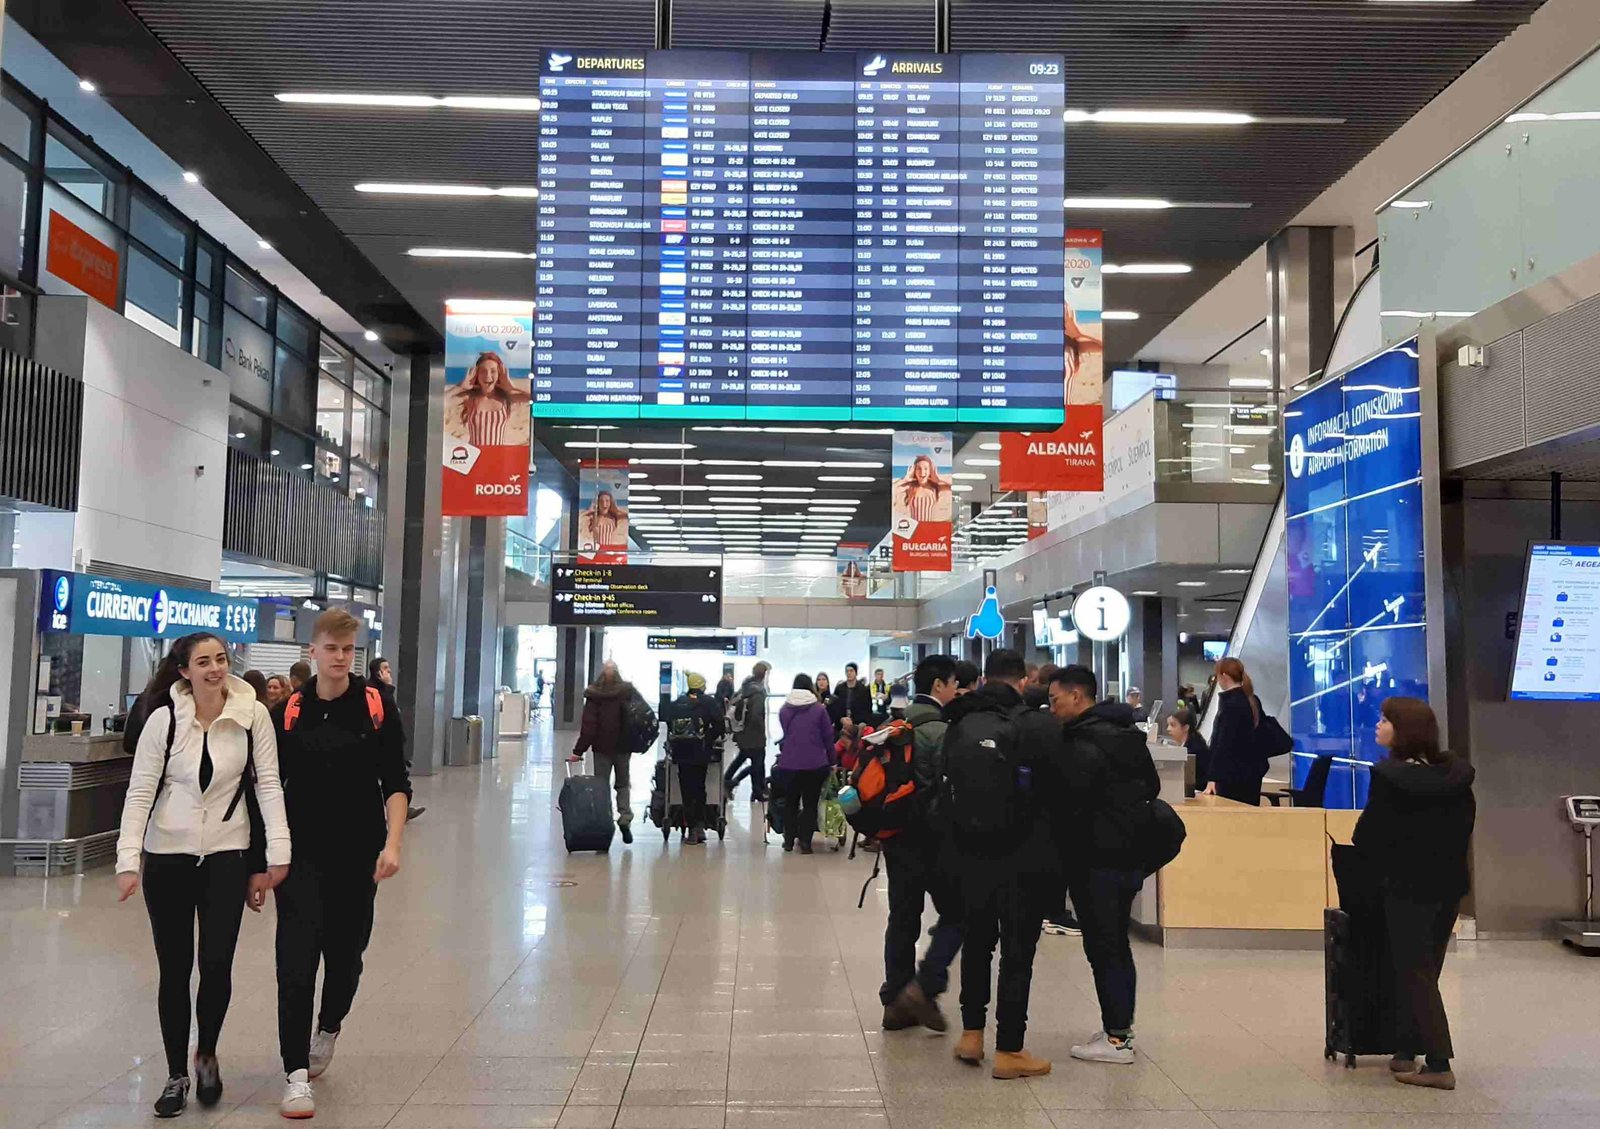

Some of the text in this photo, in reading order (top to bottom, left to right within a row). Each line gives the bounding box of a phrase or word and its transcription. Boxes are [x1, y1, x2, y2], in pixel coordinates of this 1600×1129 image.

[577, 57, 645, 70] DEPARTURES
[891, 62, 943, 74] ARRIVALS
[1029, 64, 1059, 75] 09:23
[1065, 259, 1091, 269] 2020
[475, 325, 499, 334] LATO
[501, 325, 523, 334] 2020
[239, 349, 253, 373] Bank
[1307, 392, 1404, 446] INFORMACJA LOTNISKOWA
[1026, 442, 1096, 456] ALBANIA
[1307, 428, 1389, 476] AIRPORT INFORMATION
[1064, 459, 1096, 467] TIRANA
[475, 484, 522, 496] RODOS
[902, 542, 948, 552] BUŁGARIA
[575, 569, 601, 577] Check-in
[86, 591, 151, 622] CURRENCY
[167, 600, 221, 628] EXCHANGE
[52, 610, 67, 630] ice
